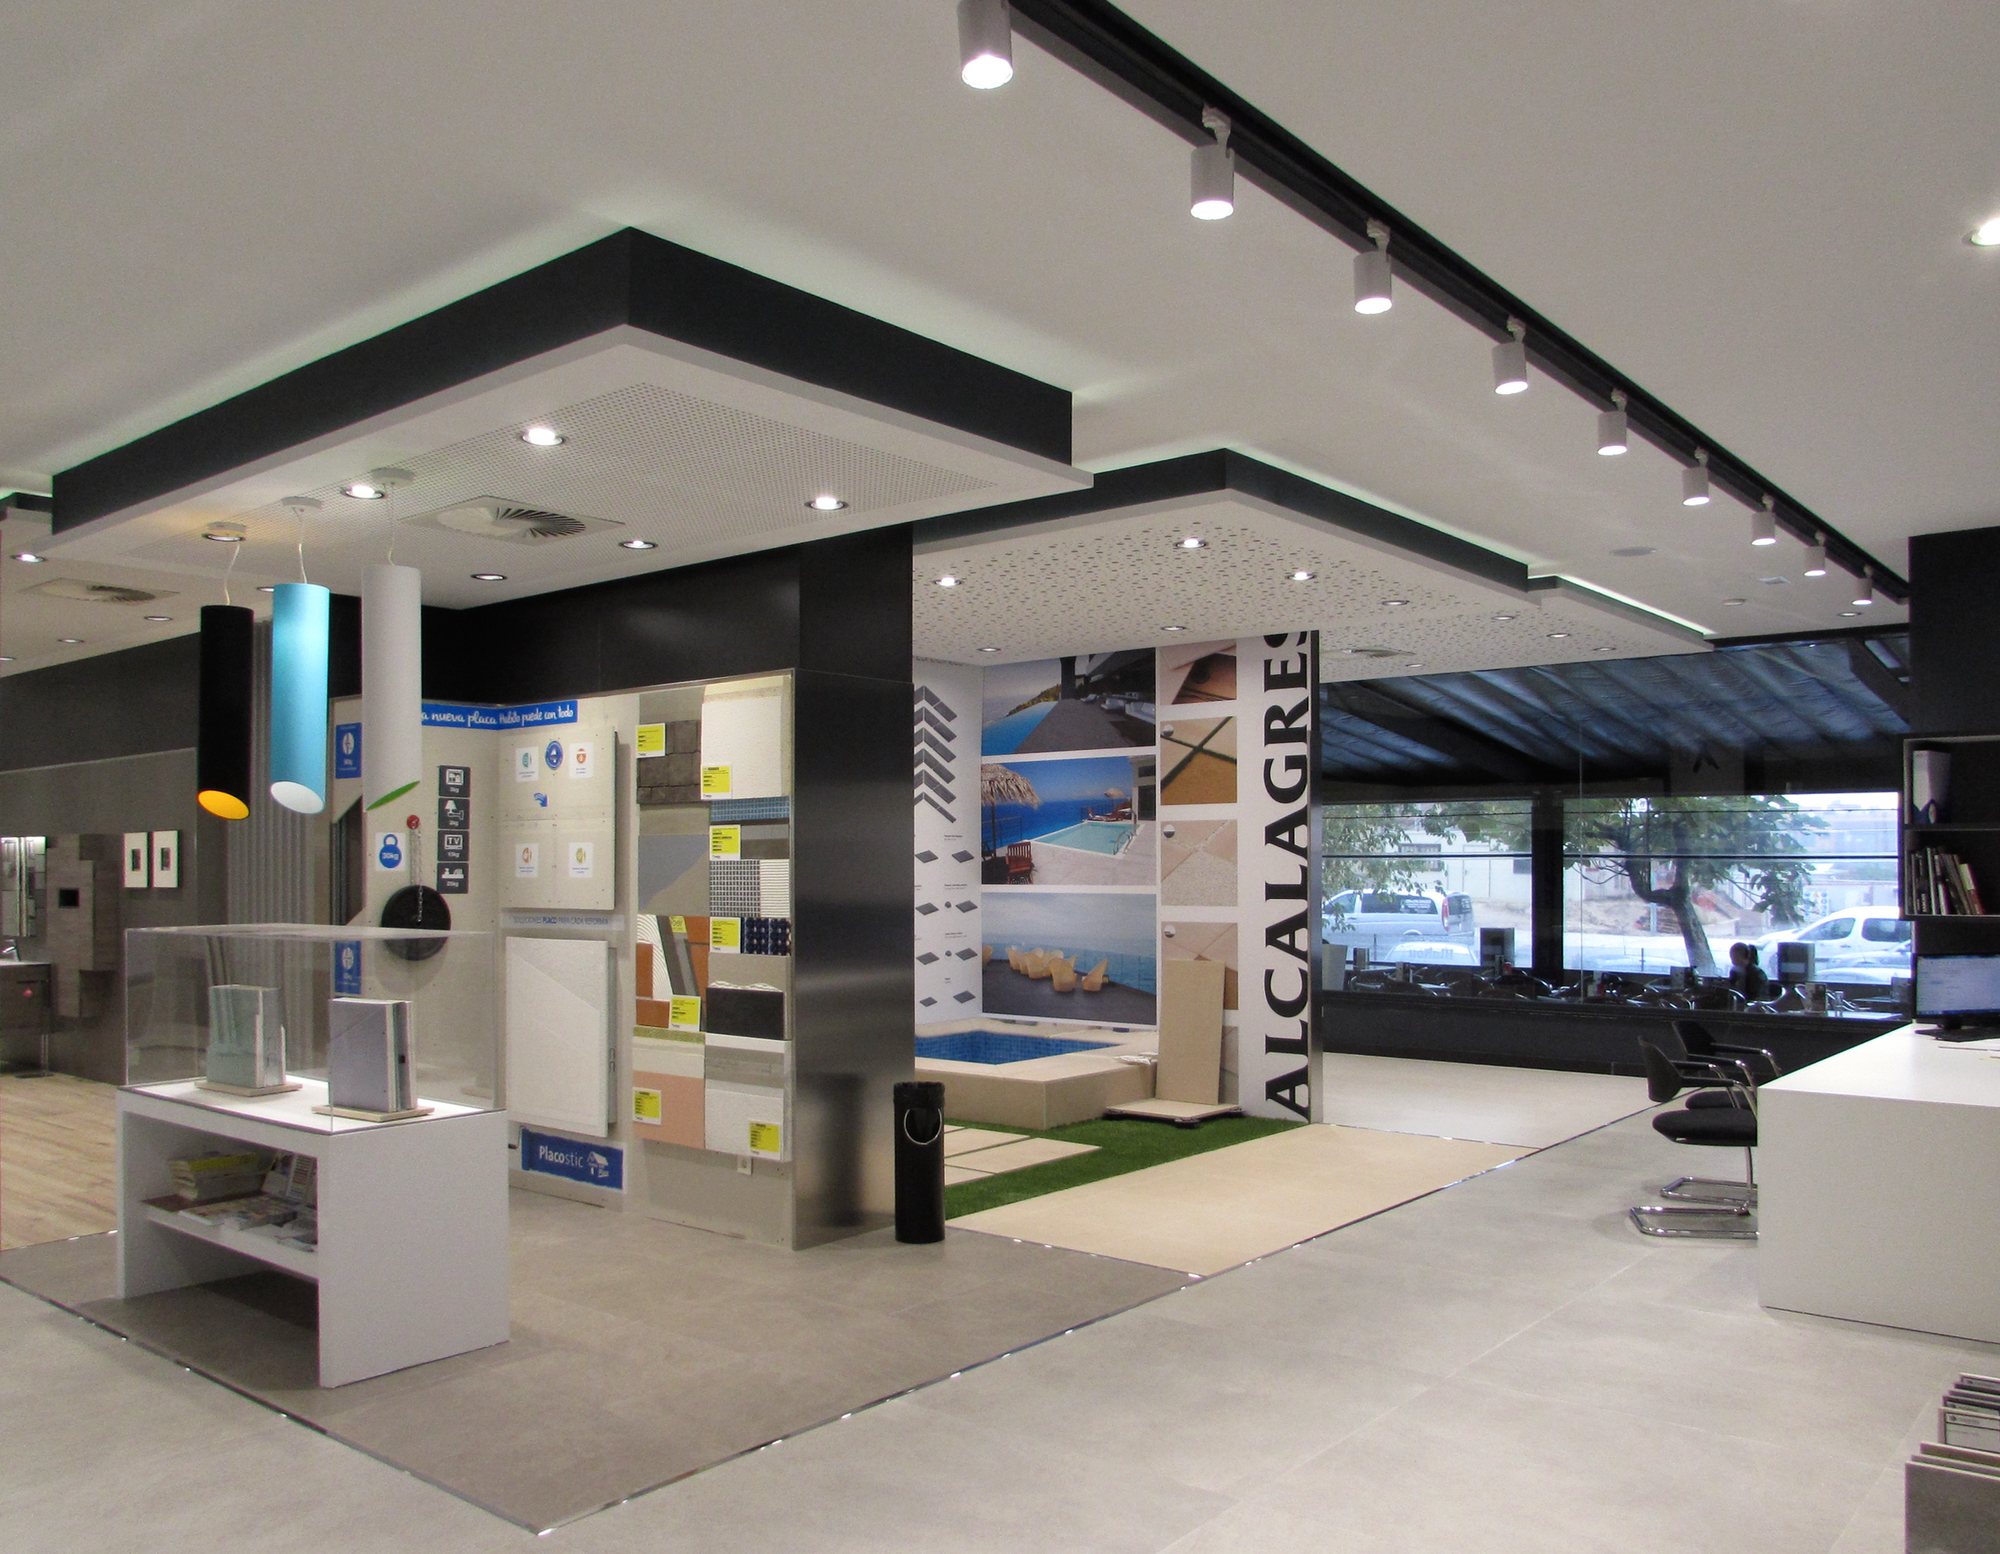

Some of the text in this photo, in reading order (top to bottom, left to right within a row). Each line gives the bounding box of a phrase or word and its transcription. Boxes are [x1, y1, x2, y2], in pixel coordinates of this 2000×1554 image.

[421, 712, 428, 721] a
[431, 713, 465, 722] nueva
[468, 711, 496, 726] placa
[522, 709, 542, 726] puede
[544, 710, 556, 720] con
[558, 704, 574, 719] todo
[447, 837, 460, 845] TV
[539, 1145, 584, 1168] Placostic
